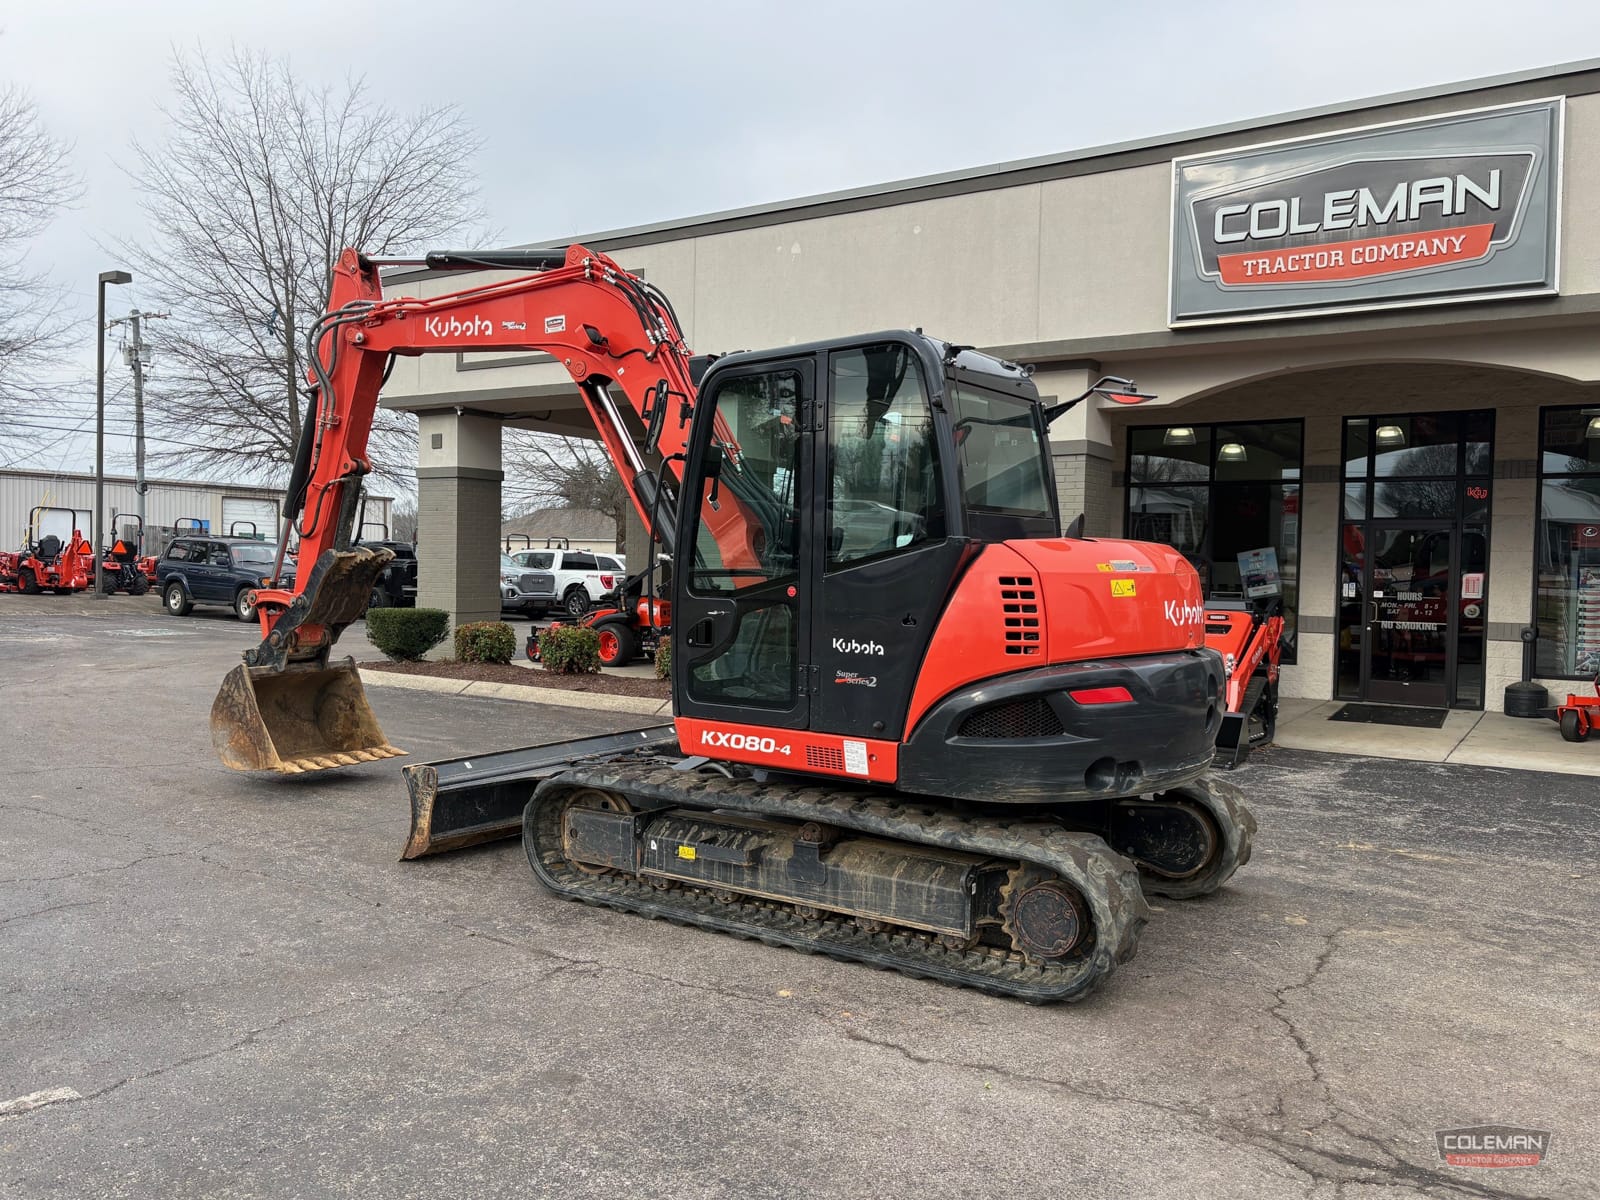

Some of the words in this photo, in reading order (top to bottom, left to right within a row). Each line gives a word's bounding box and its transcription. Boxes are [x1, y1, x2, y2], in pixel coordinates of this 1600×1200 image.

[1214, 169, 1500, 243] COLEMAN
[1243, 250, 1345, 277] TRACTOR
[1350, 235, 1466, 265] COMPANY
[425, 314, 493, 338] Kubota
[1397, 592, 1423, 601] HOURS
[1380, 621, 1394, 629] NO
[1395, 622, 1438, 631] SMOKING
[832, 637, 885, 656] Kubota
[835, 669, 859, 679] Super
[701, 729, 792, 756] KX080-4
